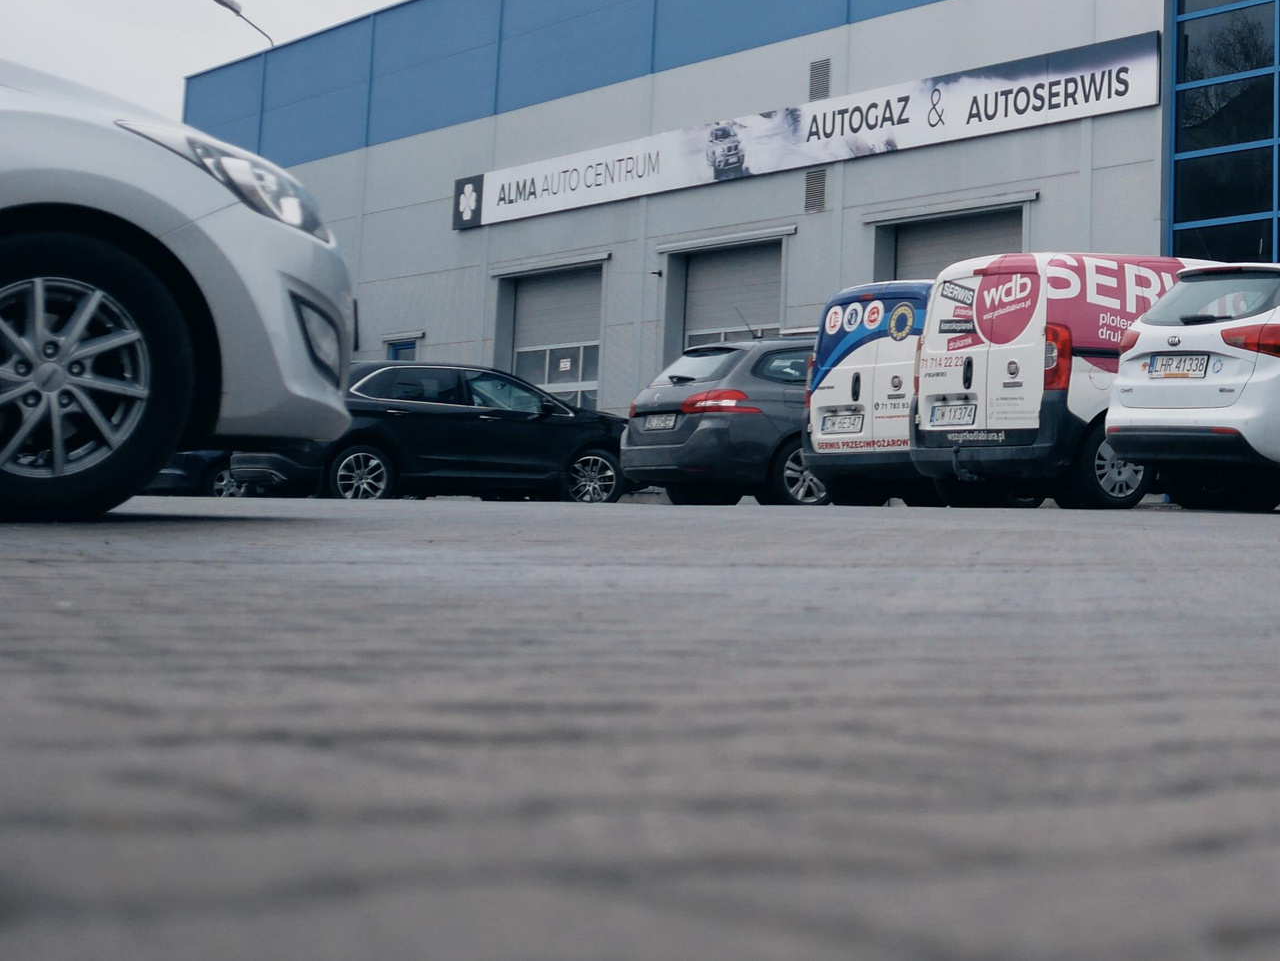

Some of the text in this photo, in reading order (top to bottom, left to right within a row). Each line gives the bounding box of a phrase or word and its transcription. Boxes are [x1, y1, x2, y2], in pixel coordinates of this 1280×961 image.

[806, 66, 1130, 142] AUTOGAZ & AUTOSERWIS
[497, 150, 660, 206] ALMA AUTO CENTRUM
[943, 283, 974, 304] SERWIS
[983, 274, 1032, 309] wdb
[944, 357, 953, 368] 22
[1154, 358, 1206, 372] LHR 41338
[935, 406, 973, 422] DW 1X374
[817, 437, 910, 450] SERWIS PRZECIWPOŻAROW
[947, 431, 1005, 442] wszystkodlabiura.pl
